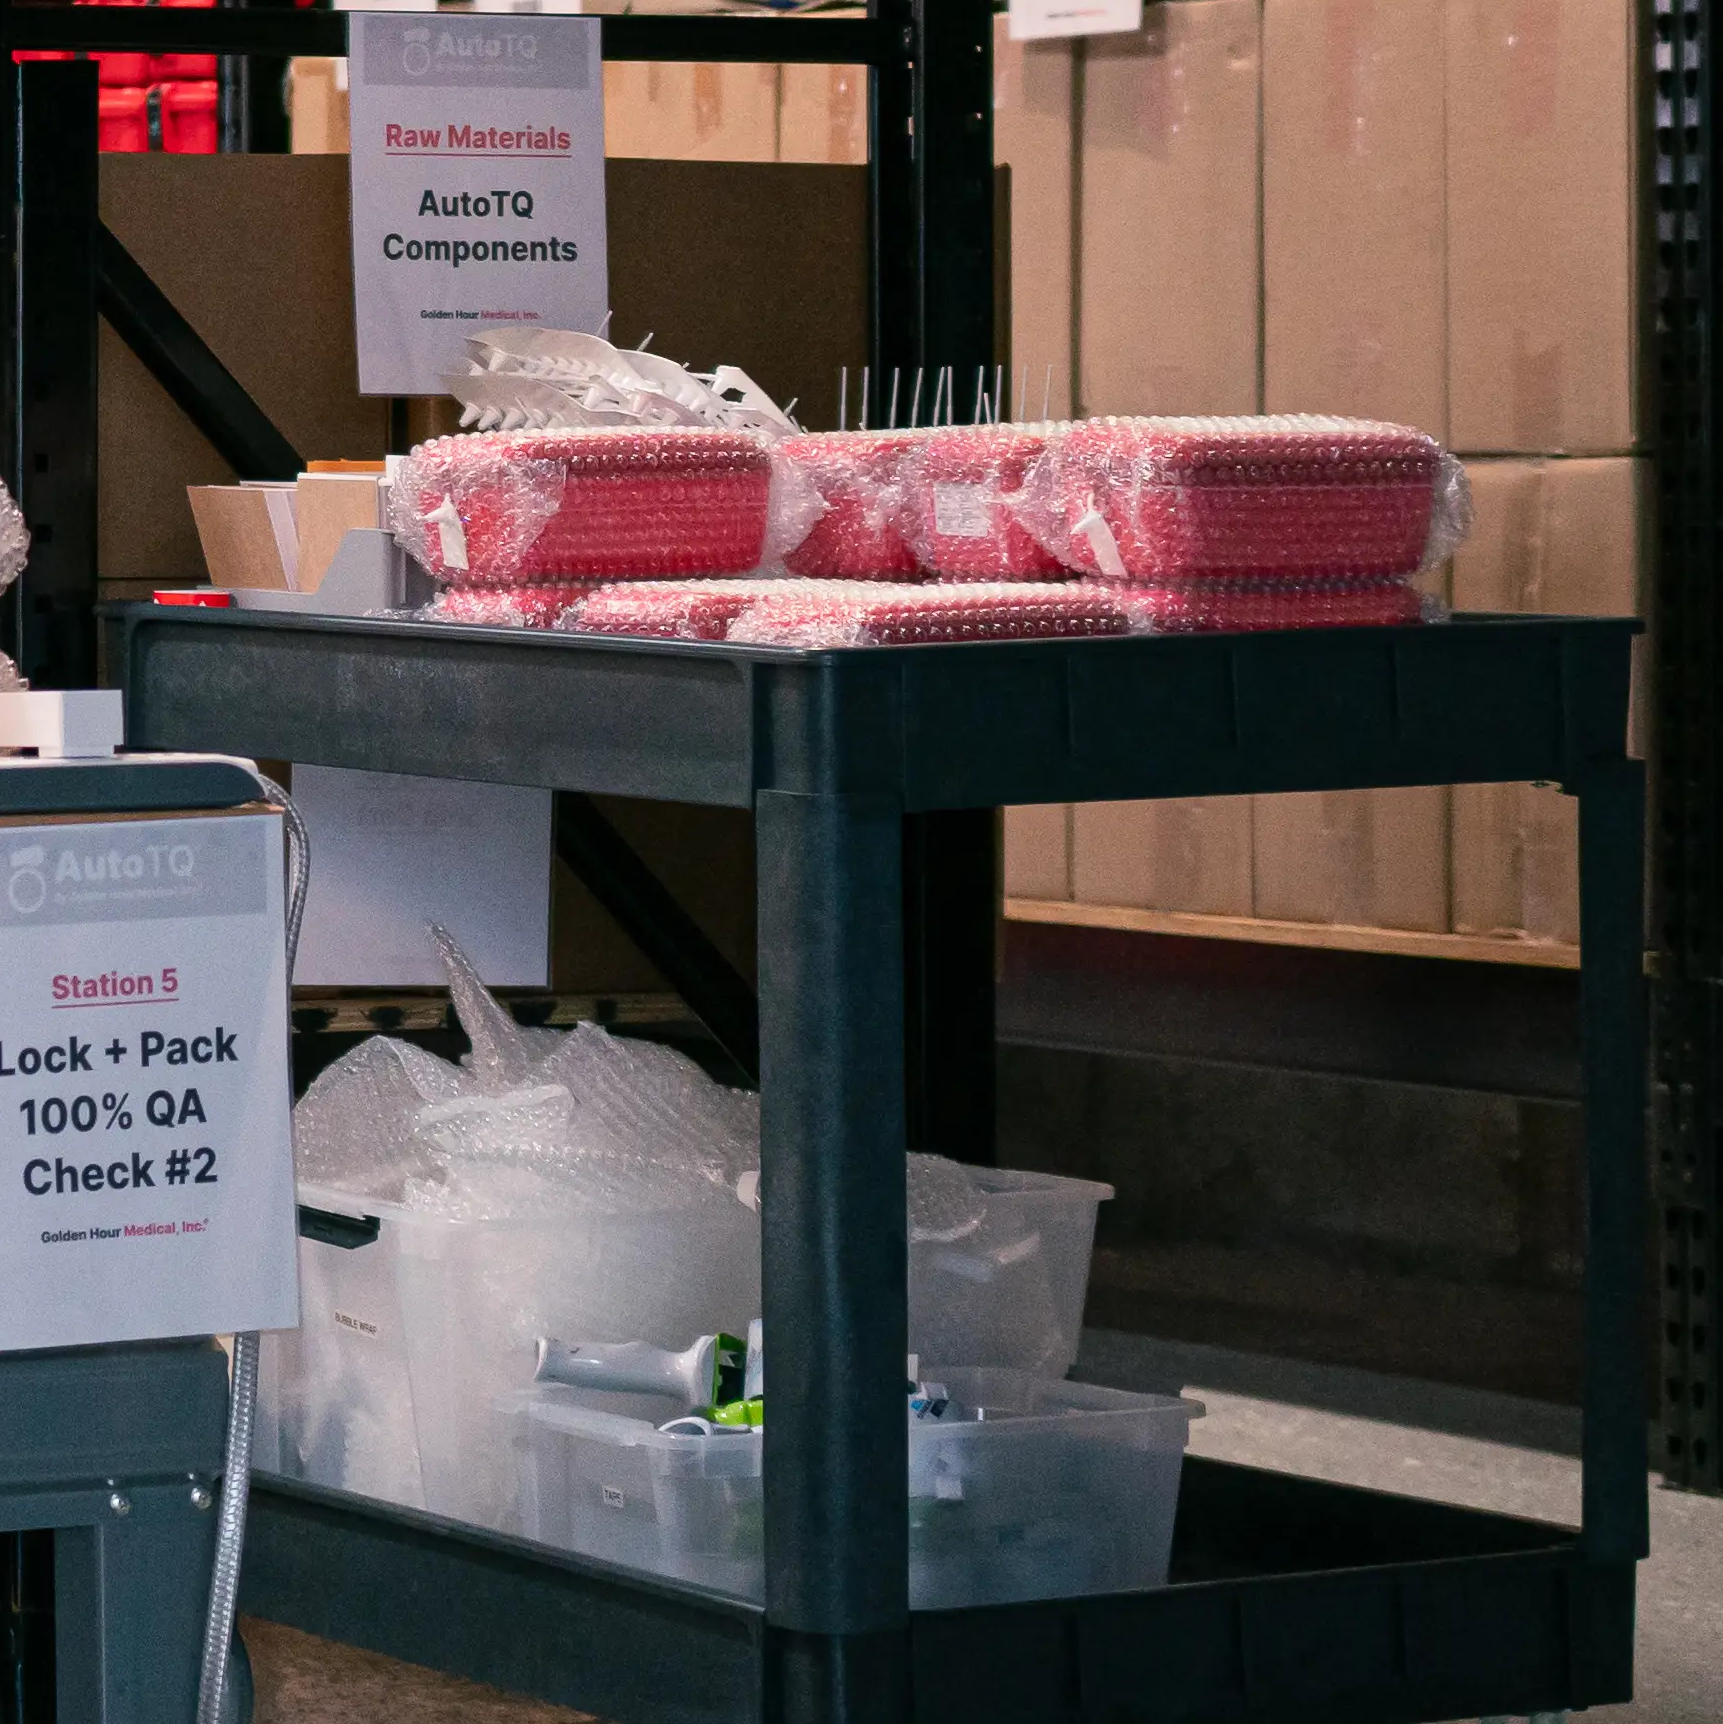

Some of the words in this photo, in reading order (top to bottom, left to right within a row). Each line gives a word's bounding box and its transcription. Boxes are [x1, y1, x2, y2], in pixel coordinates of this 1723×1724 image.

[435, 31, 538, 60] AutoTQ
[385, 123, 442, 148] Raw
[447, 124, 572, 151] Materials
[417, 189, 534, 220] AutoTQ
[383, 233, 579, 269] Components
[420, 309, 454, 320] Golden
[455, 310, 479, 320] Hour
[56, 843, 195, 882] AutoTQ
[51, 970, 154, 1001] Station
[161, 967, 180, 994] 5
[105, 1038, 128, 1064] +
[140, 1026, 240, 1067] Pack
[19, 1092, 133, 1136] 100%
[145, 1087, 208, 1128] QA
[22, 1151, 157, 1196] Check
[164, 1146, 219, 1186] #2
[40, 1229, 87, 1244] Golden
[89, 1227, 123, 1240] Hour
[123, 1221, 180, 1237] Medical,
